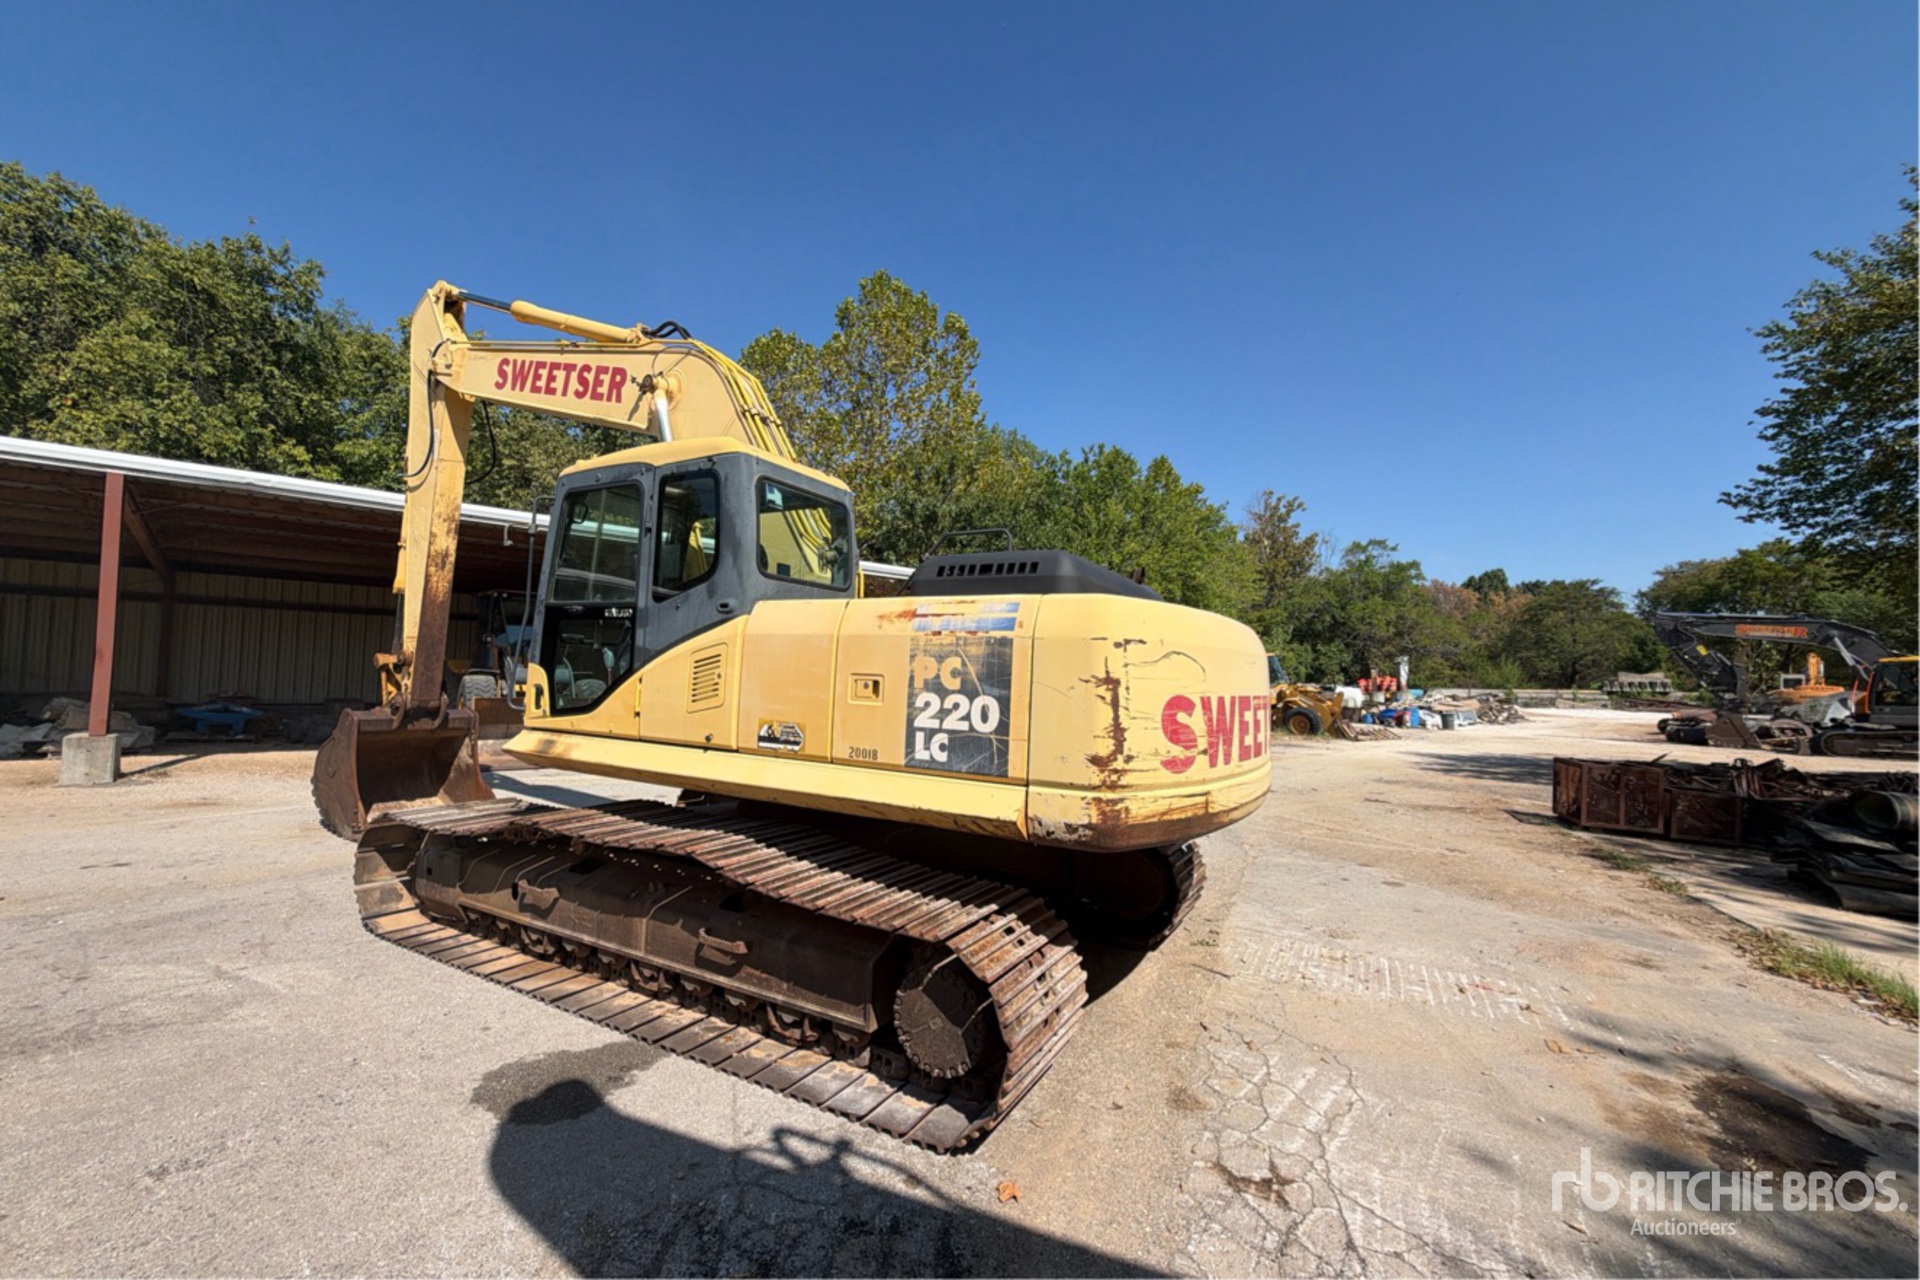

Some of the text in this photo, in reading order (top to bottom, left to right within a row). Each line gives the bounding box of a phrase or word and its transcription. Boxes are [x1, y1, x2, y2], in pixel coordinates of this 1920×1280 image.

[494, 357, 628, 404] SWEETSER
[913, 655, 962, 691] PC
[913, 692, 1001, 734] 220
[848, 746, 879, 761] 20018
[914, 730, 949, 763] LC
